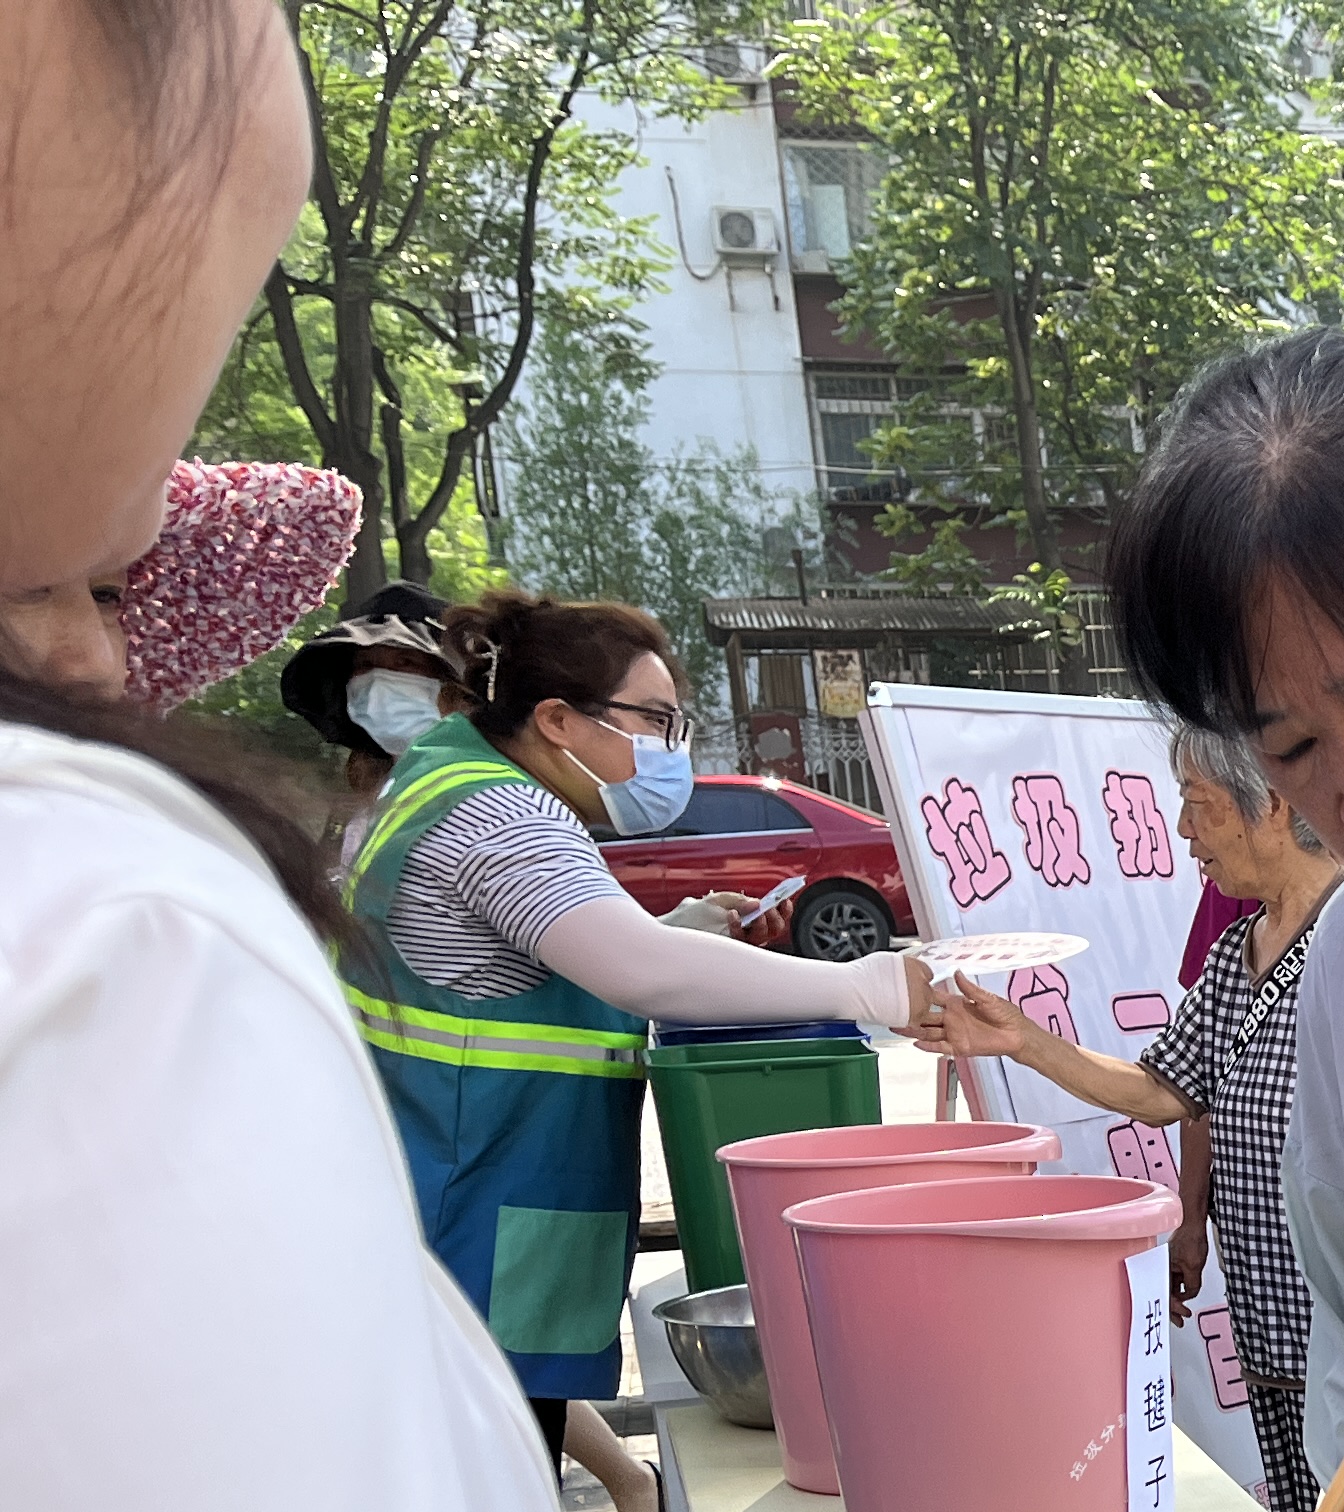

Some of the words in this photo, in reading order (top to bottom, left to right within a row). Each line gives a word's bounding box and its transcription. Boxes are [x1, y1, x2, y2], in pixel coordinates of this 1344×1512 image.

[920, 767, 1208, 910] 垃圾扔
[1143, 1298, 1168, 1509] 投毽子
